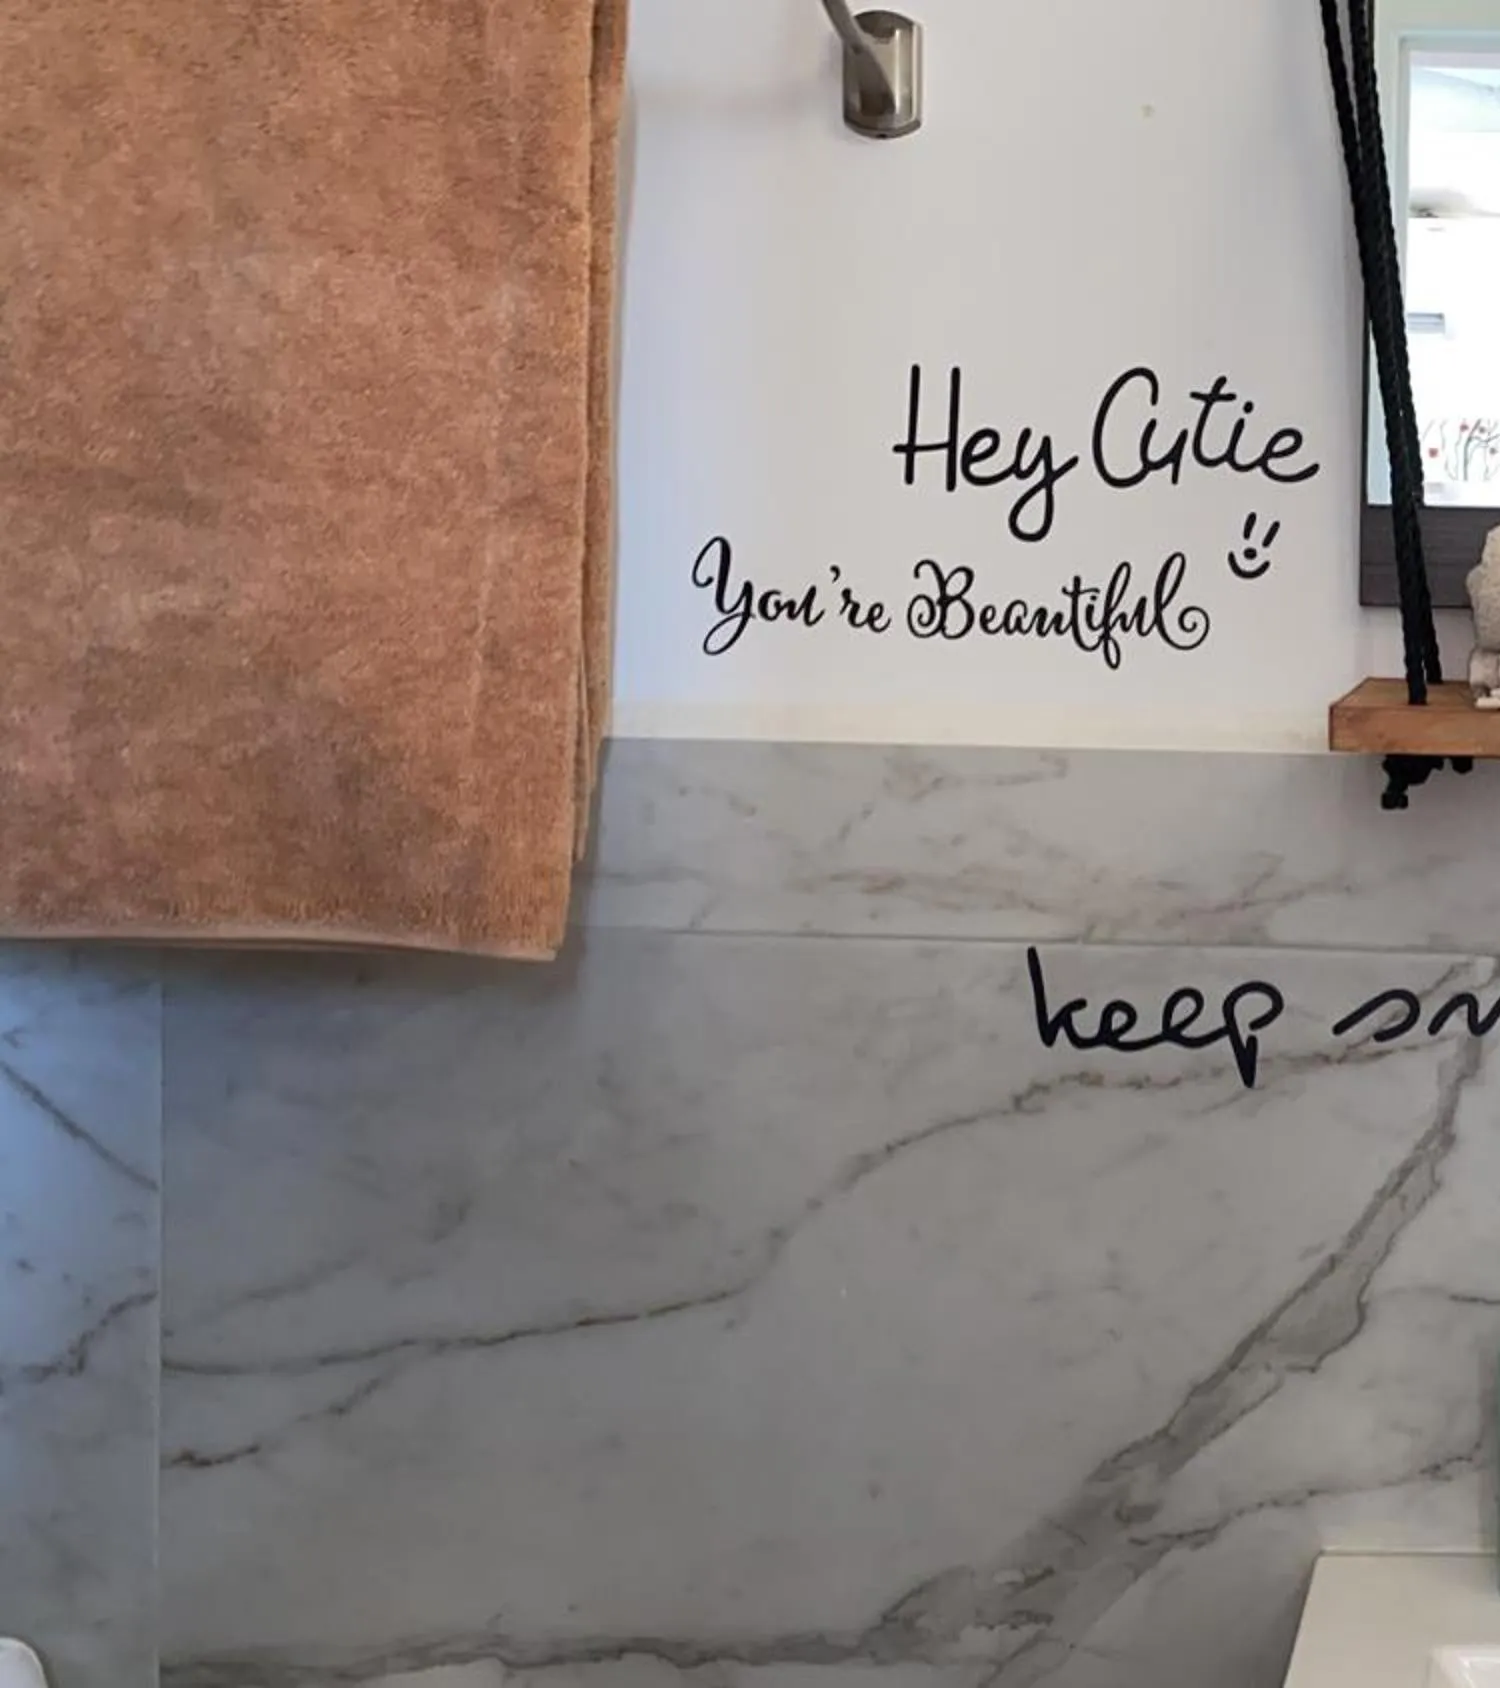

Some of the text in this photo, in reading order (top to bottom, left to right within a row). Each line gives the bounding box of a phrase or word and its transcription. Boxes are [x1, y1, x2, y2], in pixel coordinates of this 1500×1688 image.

[893, 365, 1319, 542] Hey Cutie
[693, 537, 1209, 669] You're Beautiful
[1028, 948, 1283, 1088] keep
